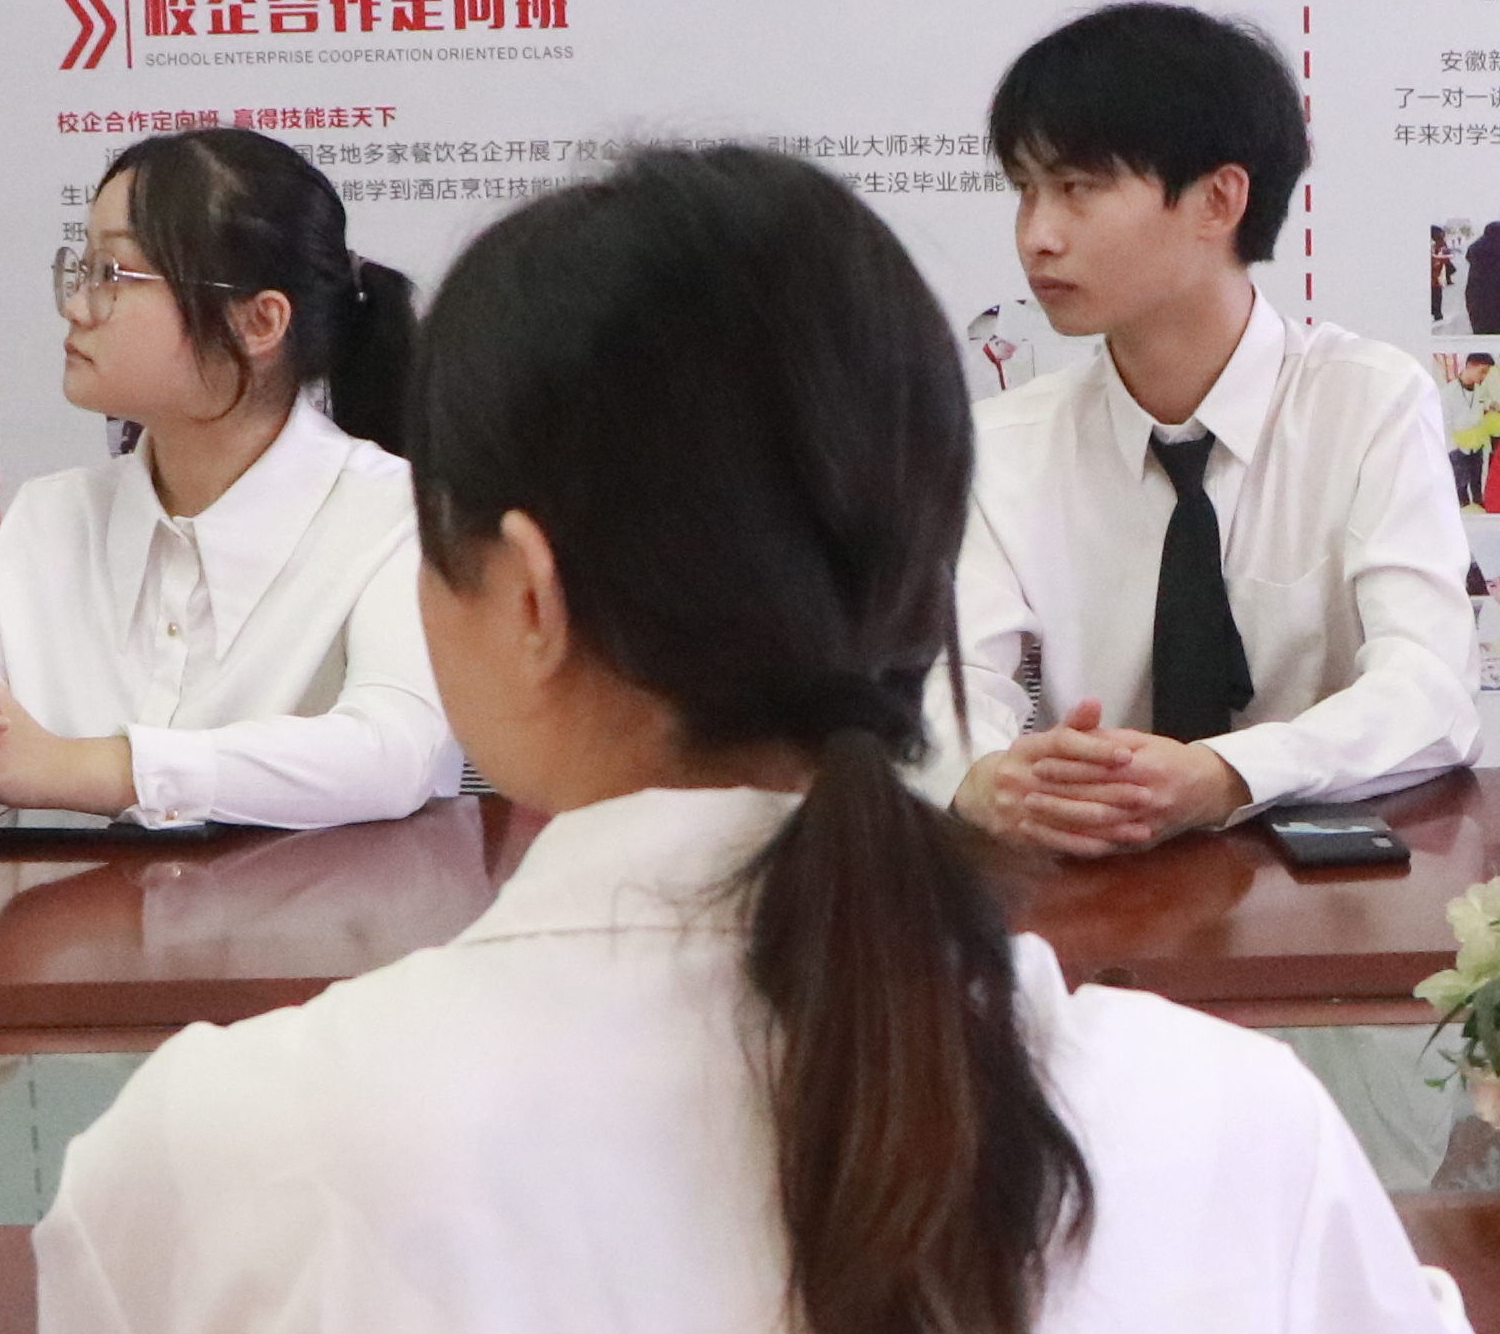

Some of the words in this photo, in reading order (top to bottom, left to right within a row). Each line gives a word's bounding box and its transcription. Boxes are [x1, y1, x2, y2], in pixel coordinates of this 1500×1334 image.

[146, 52, 208, 67] SCHOOL
[214, 50, 313, 65] ENTERPRISE
[318, 49, 432, 63] COOPERATION
[437, 47, 518, 61] ORIENTED
[522, 46, 573, 59] CLASS
[57, 110, 219, 133] 校企合作定向班
[233, 106, 397, 130] 赢得技能走天下
